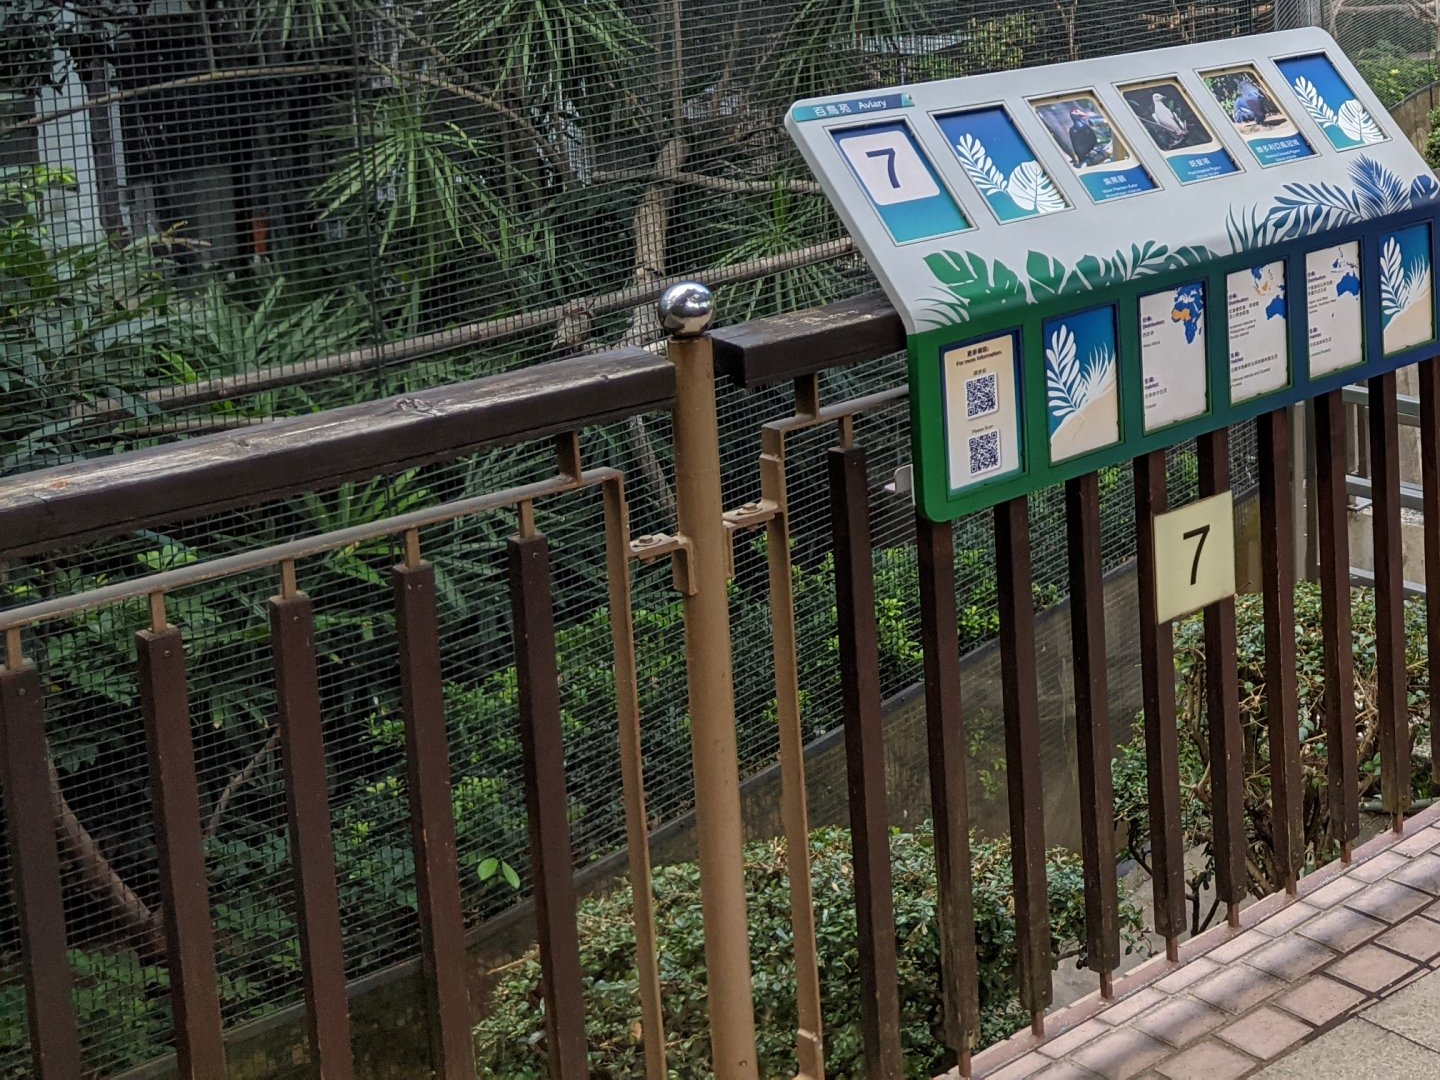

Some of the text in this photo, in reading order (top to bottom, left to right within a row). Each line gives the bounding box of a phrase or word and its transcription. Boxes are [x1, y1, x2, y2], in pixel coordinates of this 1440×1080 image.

[813, 99, 887, 117] 百鳥苑 Aviary
[865, 147, 901, 189] 7
[1182, 523, 1211, 586] 7
